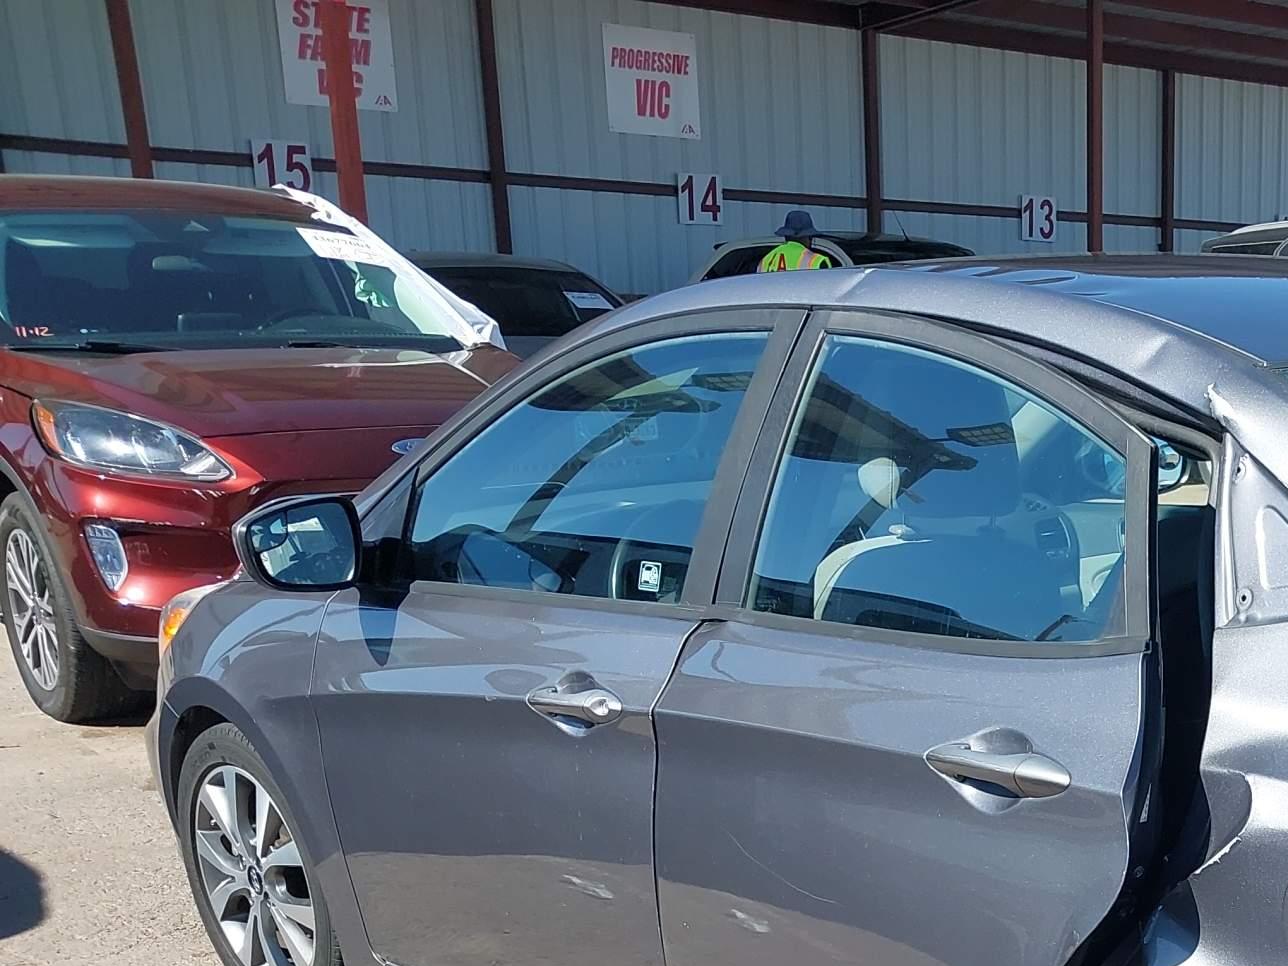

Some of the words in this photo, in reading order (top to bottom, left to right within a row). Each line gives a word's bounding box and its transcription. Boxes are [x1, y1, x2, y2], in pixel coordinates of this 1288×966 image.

[298, 32, 371, 66] FAM
[610, 46, 690, 76] PROGRESSIVE
[635, 78, 671, 120] VIC
[257, 143, 310, 193] 15
[681, 175, 720, 221] 14
[1023, 198, 1054, 239] 13
